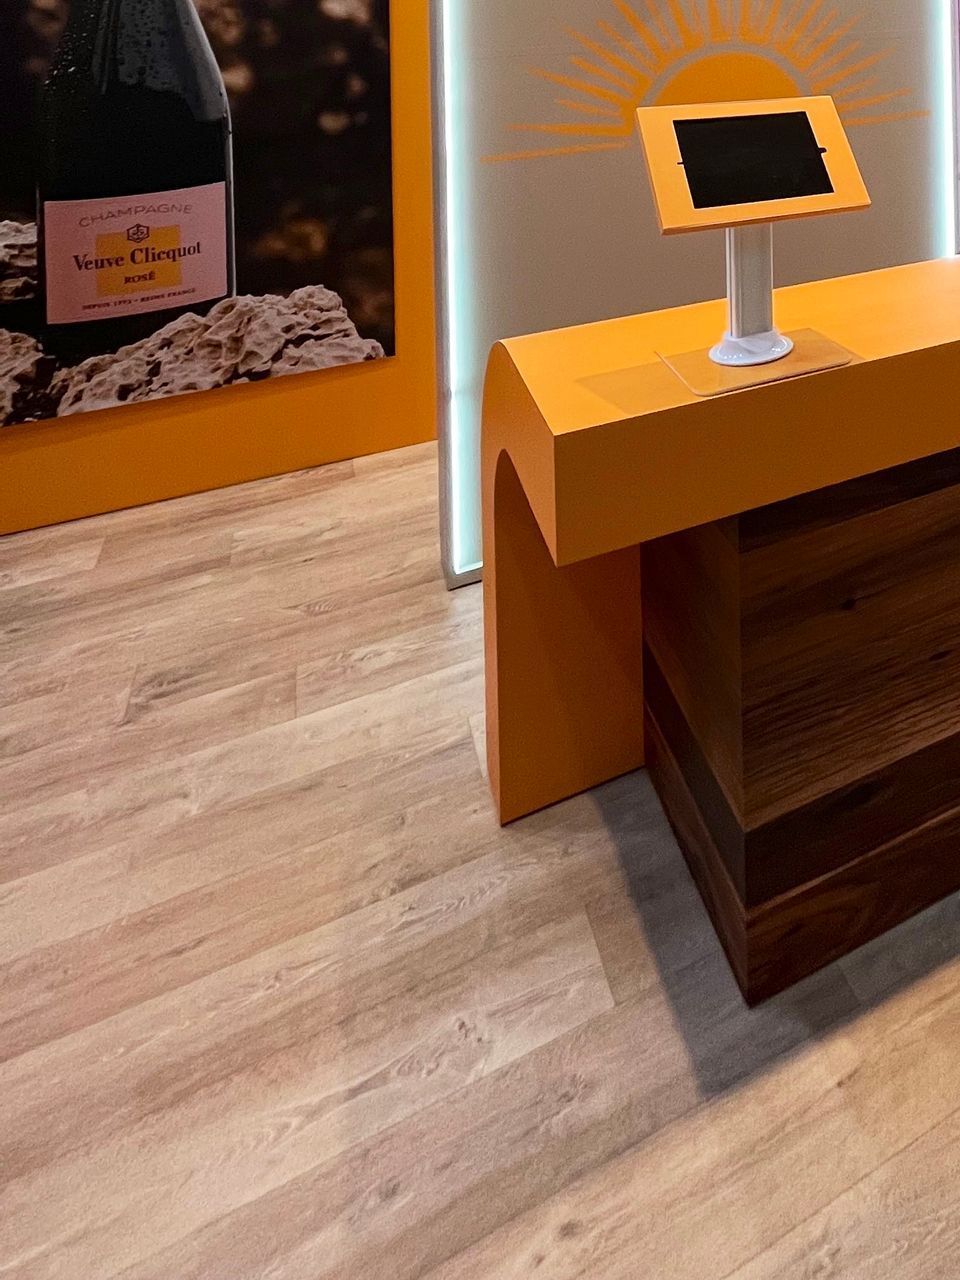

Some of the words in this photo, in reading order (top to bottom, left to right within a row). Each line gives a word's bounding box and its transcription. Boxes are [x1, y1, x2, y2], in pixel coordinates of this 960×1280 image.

[78, 203, 193, 228] CHAMPAGNE
[73, 252, 125, 271] Veuve
[130, 241, 201, 266] Clicquot
[124, 271, 156, 285] ROSÉ
